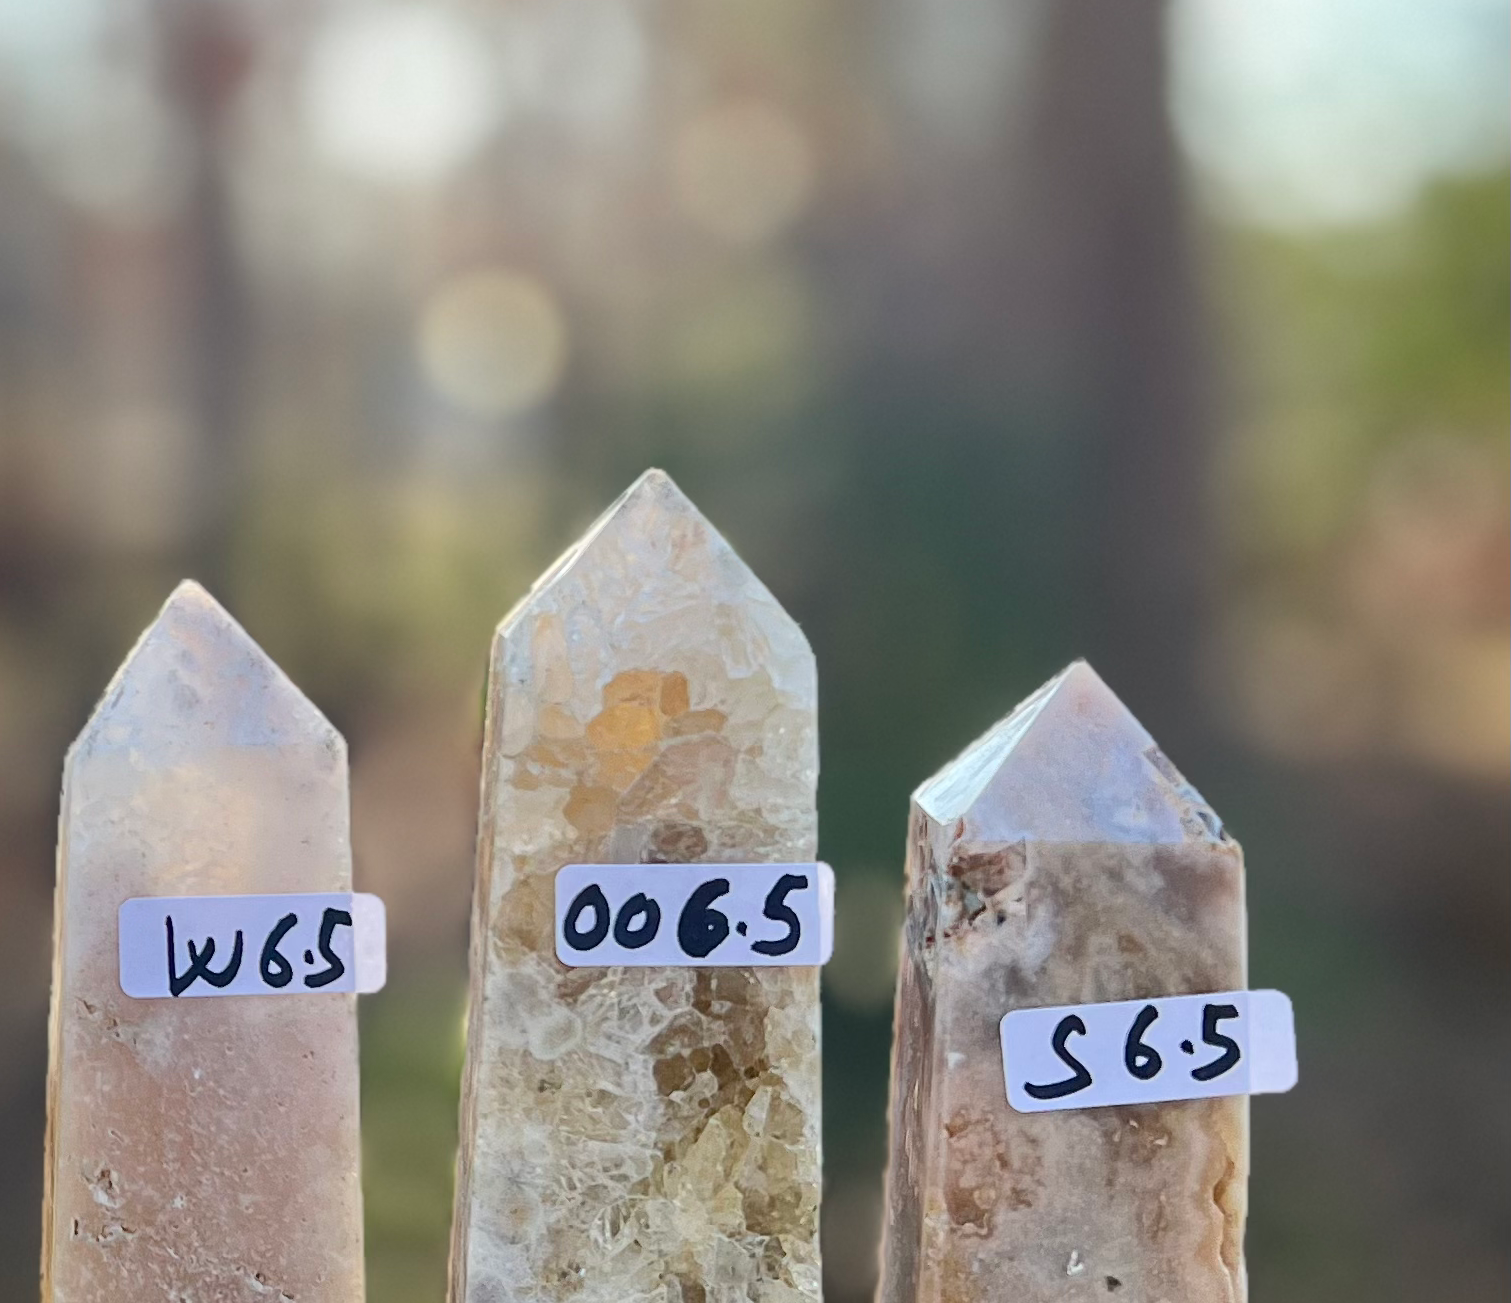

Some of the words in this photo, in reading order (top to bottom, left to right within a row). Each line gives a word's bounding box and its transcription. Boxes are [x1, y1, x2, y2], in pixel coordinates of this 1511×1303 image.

[165, 915, 244, 998] W
[259, 907, 353, 989] 6.5
[677, 873, 809, 959] 6.5
[1023, 1014, 1093, 1100] S
[1124, 1003, 1241, 1082] 6.5
